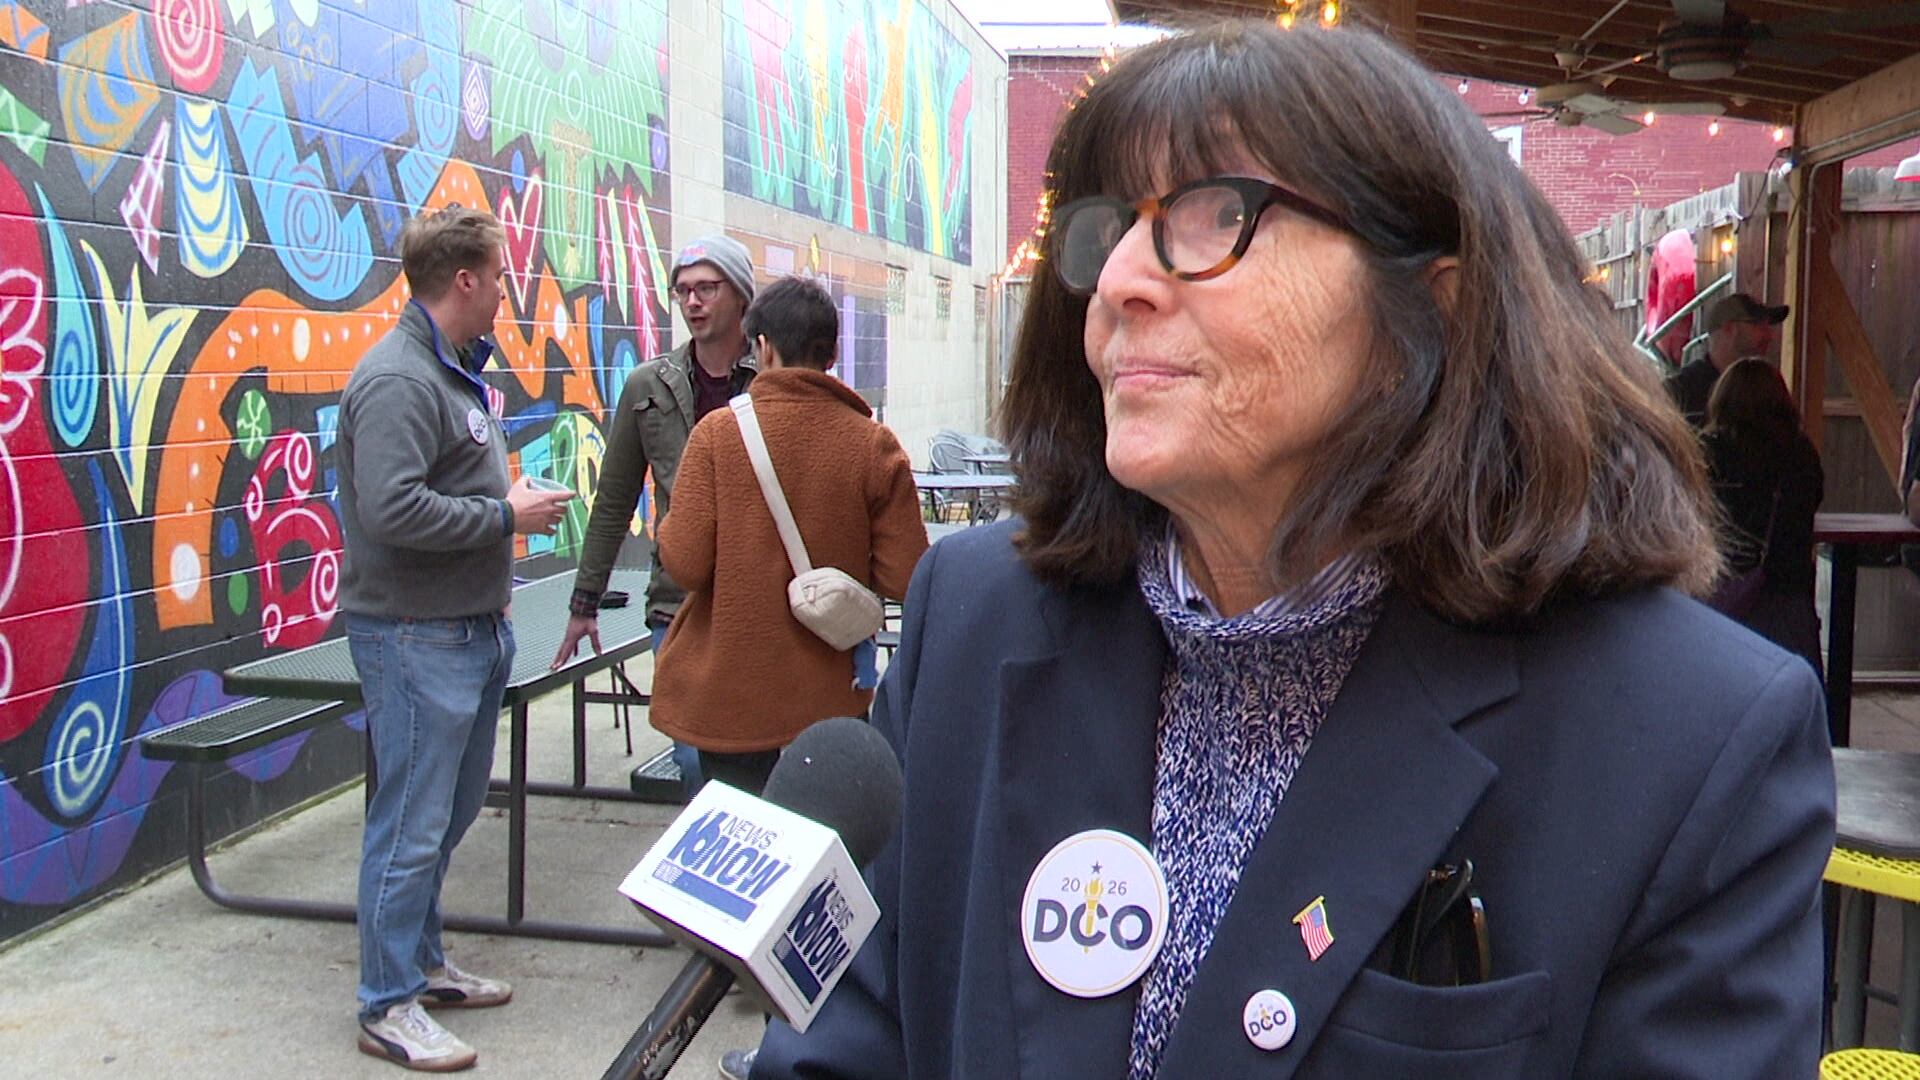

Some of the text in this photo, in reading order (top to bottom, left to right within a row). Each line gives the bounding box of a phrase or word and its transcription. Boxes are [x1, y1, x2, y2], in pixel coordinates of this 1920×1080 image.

[721, 816, 778, 850] NEWS
[690, 836, 792, 900] NOW
[1061, 877, 1128, 895] 20 26
[1033, 898, 1153, 951] DCO
[797, 911, 851, 982] NOW
[1249, 1010, 1287, 1037] DCO
